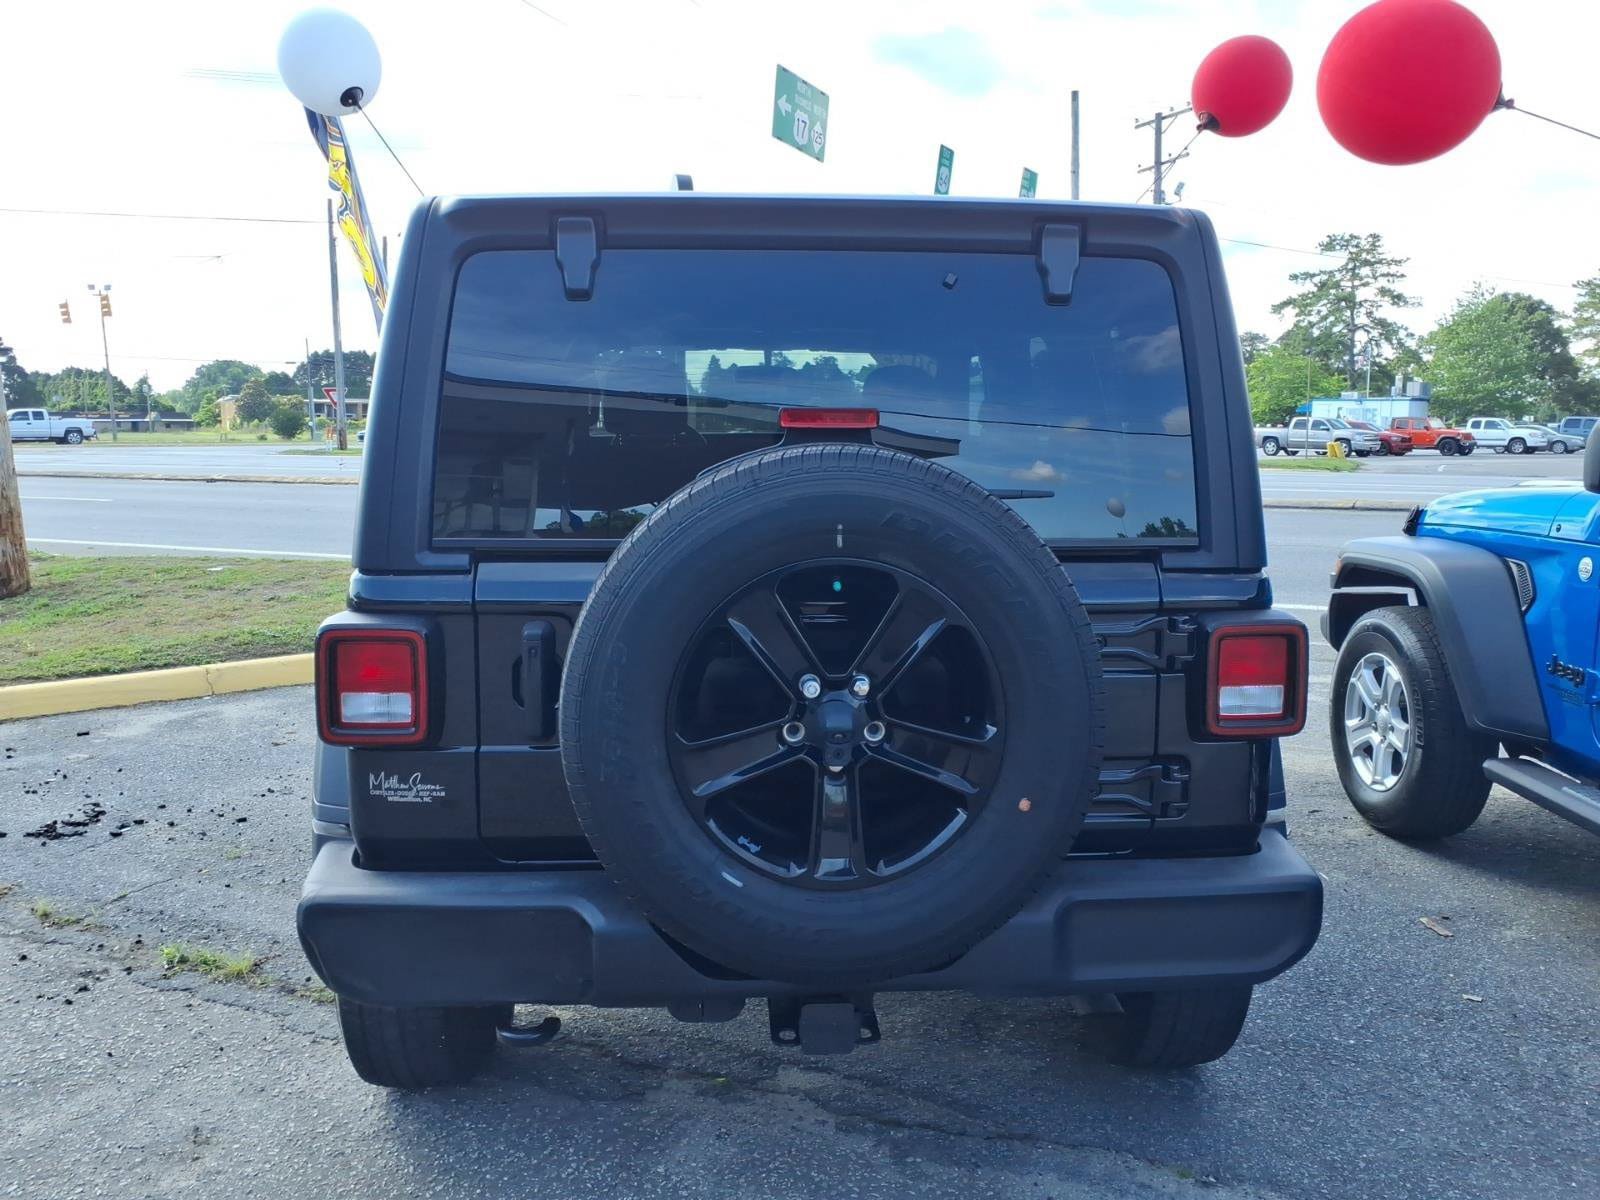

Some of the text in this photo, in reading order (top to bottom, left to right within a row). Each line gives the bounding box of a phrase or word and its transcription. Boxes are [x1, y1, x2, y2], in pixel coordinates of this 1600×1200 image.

[796, 117, 808, 139] 17
[812, 129, 823, 145] 125
[1546, 654, 1586, 689] Jeep
